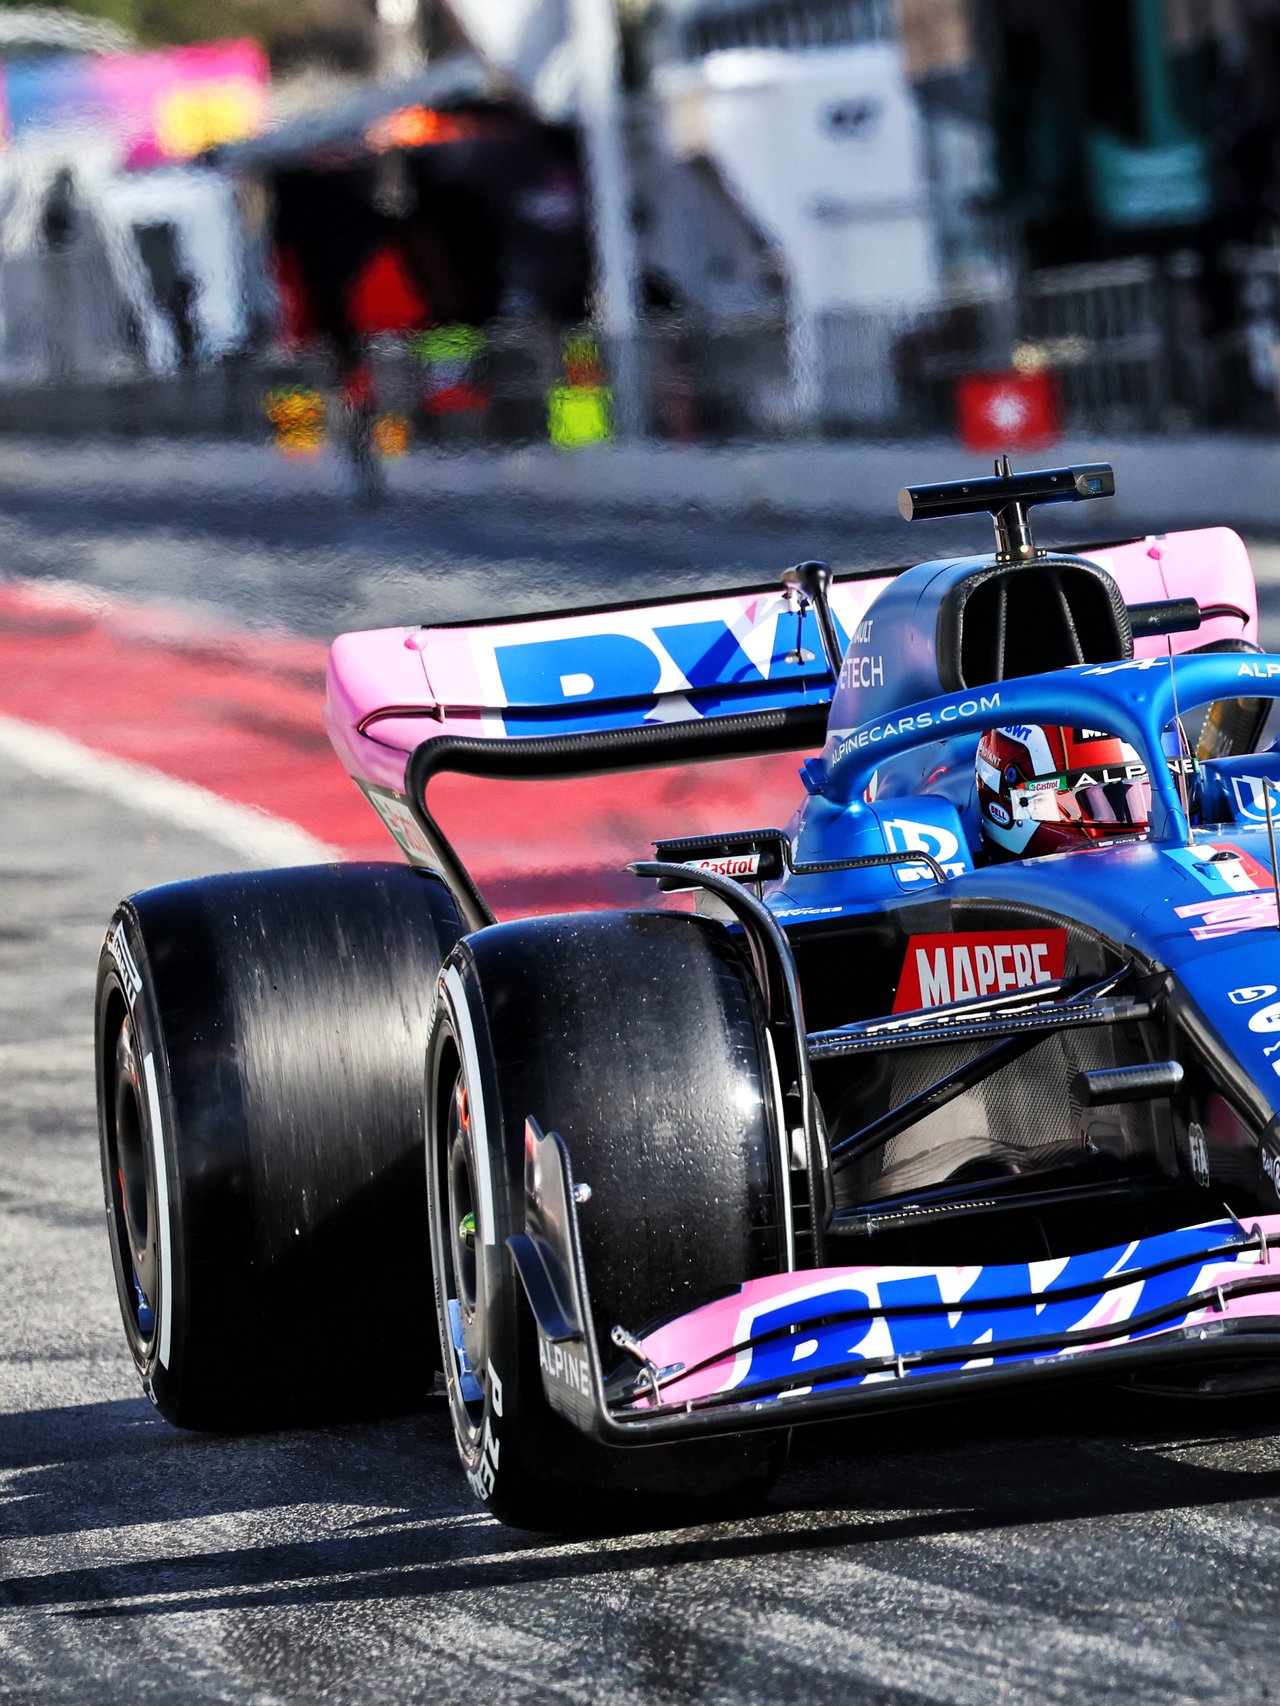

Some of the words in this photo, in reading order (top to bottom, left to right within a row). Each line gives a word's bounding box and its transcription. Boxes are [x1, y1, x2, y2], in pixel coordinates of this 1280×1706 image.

[831, 692, 1001, 768] ALPINECARS.COM
[1036, 780, 1058, 791] Castrol
[1074, 758, 1194, 788] ALPNE
[990, 806, 1008, 820] BELL
[538, 1336, 592, 1398] ALPINE
